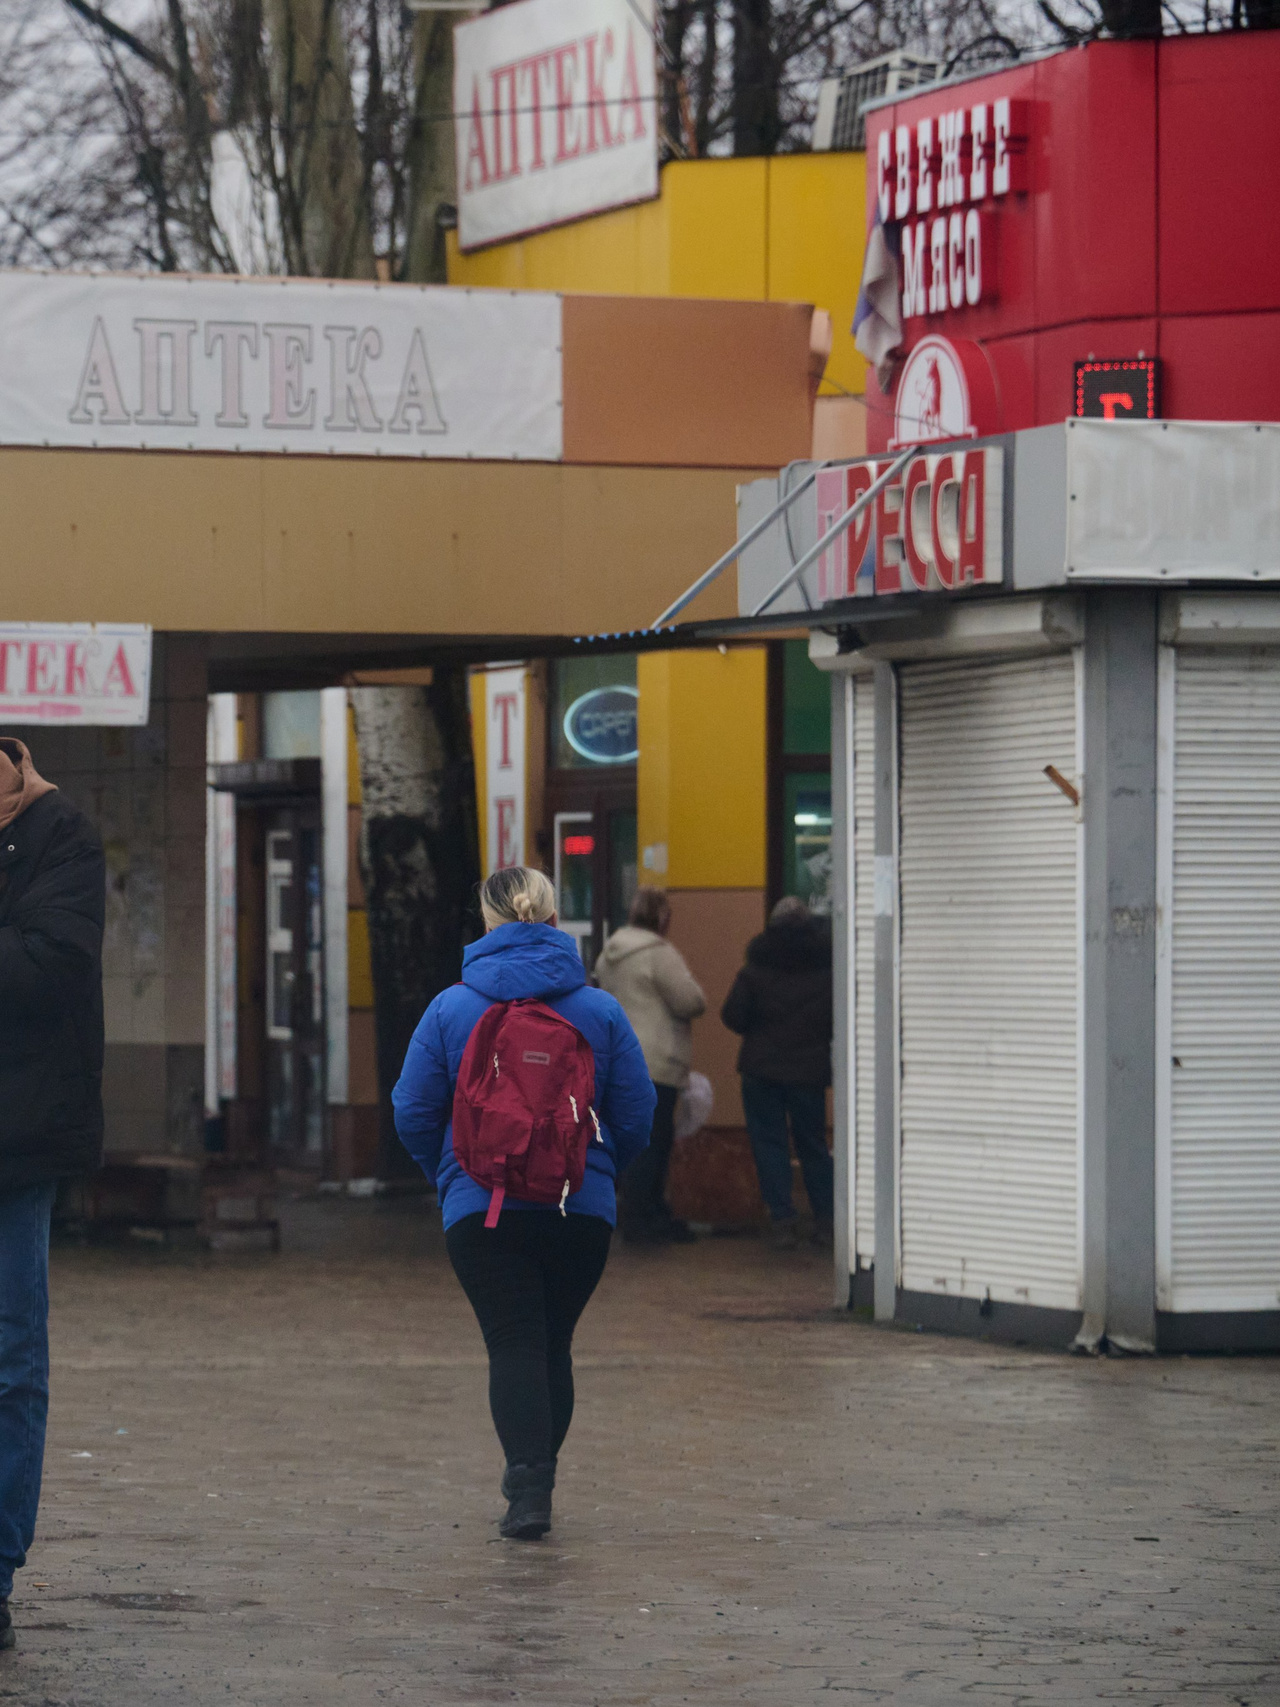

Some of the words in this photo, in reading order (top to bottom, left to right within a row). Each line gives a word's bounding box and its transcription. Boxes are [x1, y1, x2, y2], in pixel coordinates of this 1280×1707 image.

[464, 18, 646, 192] АПТЕКА
[878, 97, 1010, 224] СВЕЖЕЕ
[902, 208, 981, 319] МЯСО
[67, 314, 448, 434] АПТЕКА
[816, 448, 986, 599] ПРЕССА
